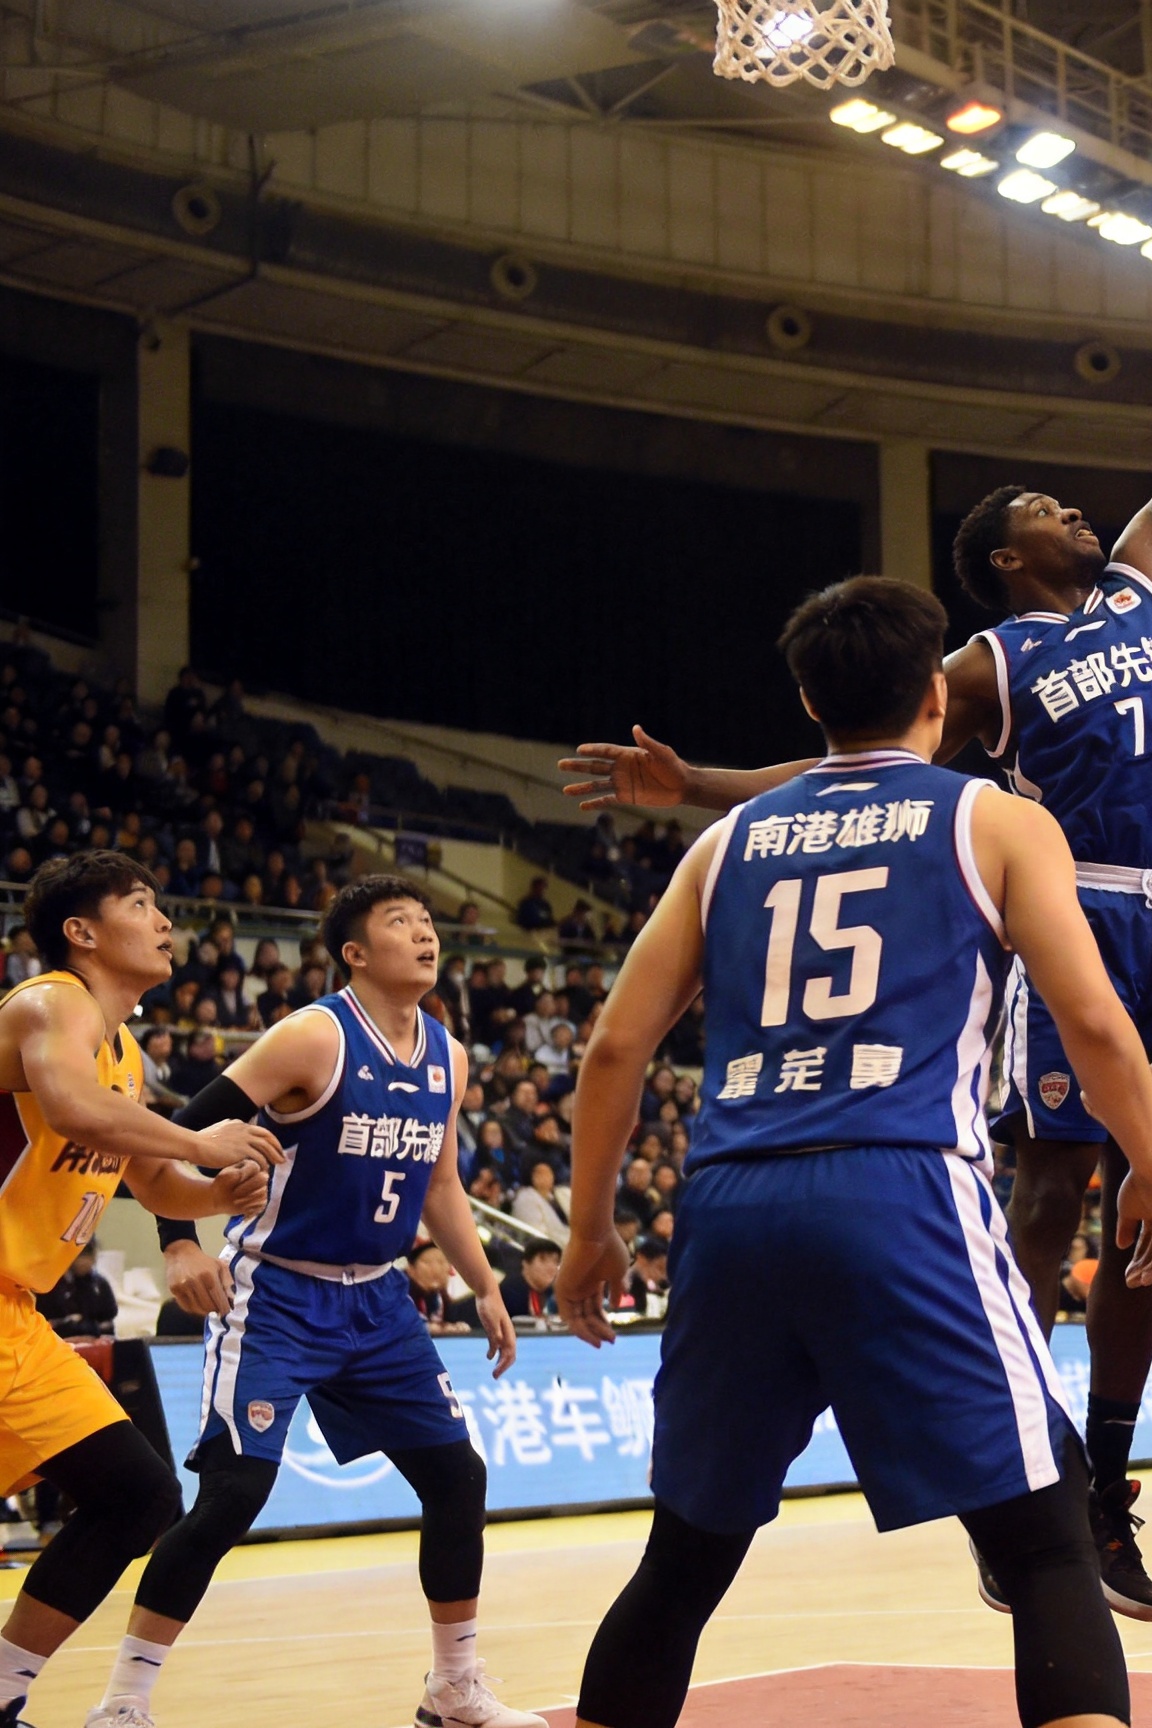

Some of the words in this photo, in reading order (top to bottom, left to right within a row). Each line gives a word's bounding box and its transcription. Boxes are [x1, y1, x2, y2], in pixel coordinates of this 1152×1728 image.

[1113, 697, 1145, 757] 7
[743, 799, 935, 861] 南港雄狮
[761, 866, 889, 1027] 15
[373, 1170, 406, 1223] 5
